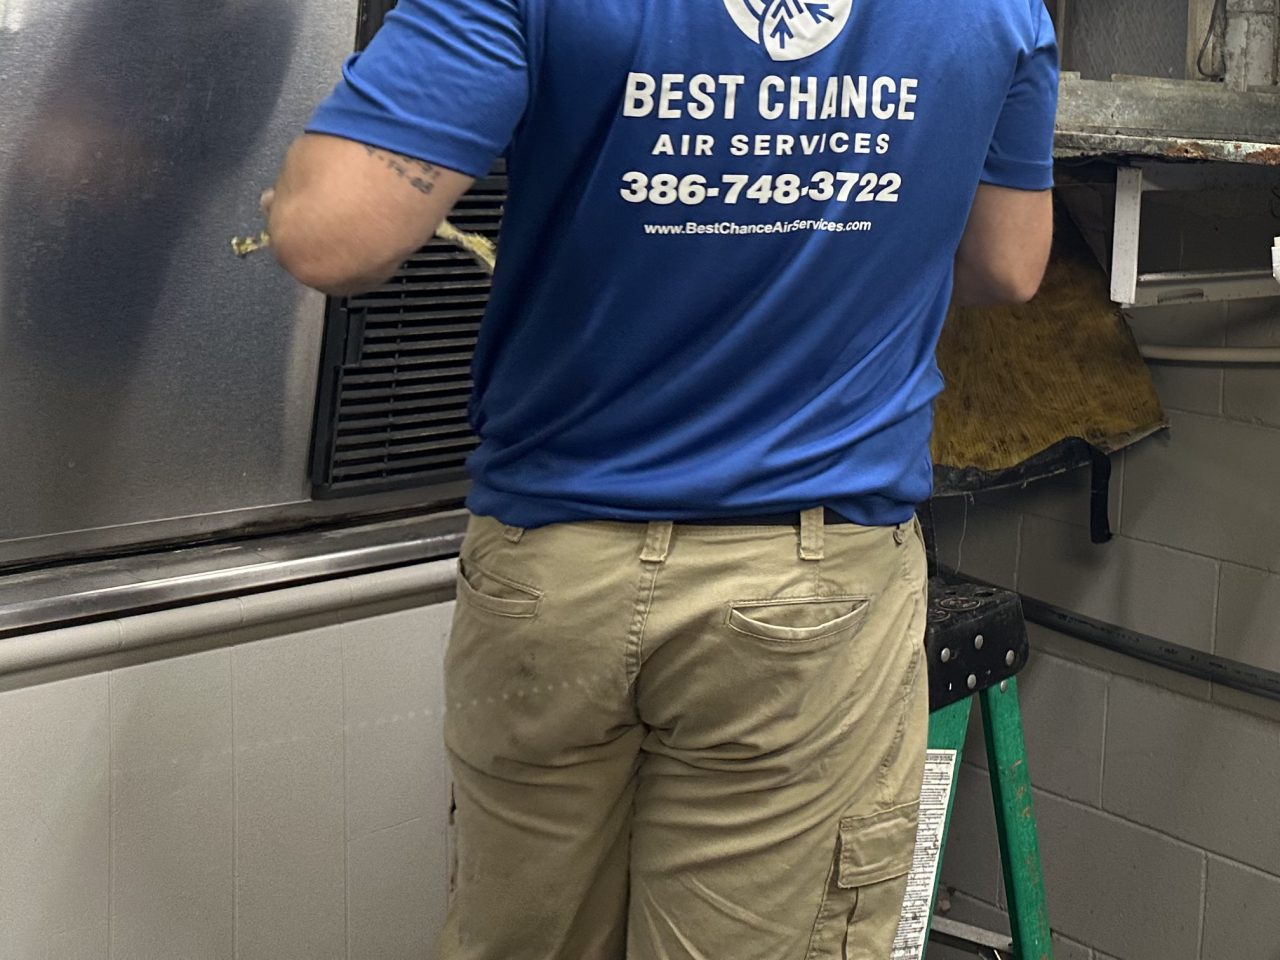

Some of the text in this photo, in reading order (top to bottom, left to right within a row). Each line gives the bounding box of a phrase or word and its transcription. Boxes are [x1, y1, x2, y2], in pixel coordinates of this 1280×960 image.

[622, 72, 919, 121] BEST CHANCE
[651, 131, 890, 157] AIR SERVICES
[620, 171, 902, 206] 386-748-3722
[643, 217, 872, 236] www.BestChanceAirServices.com
